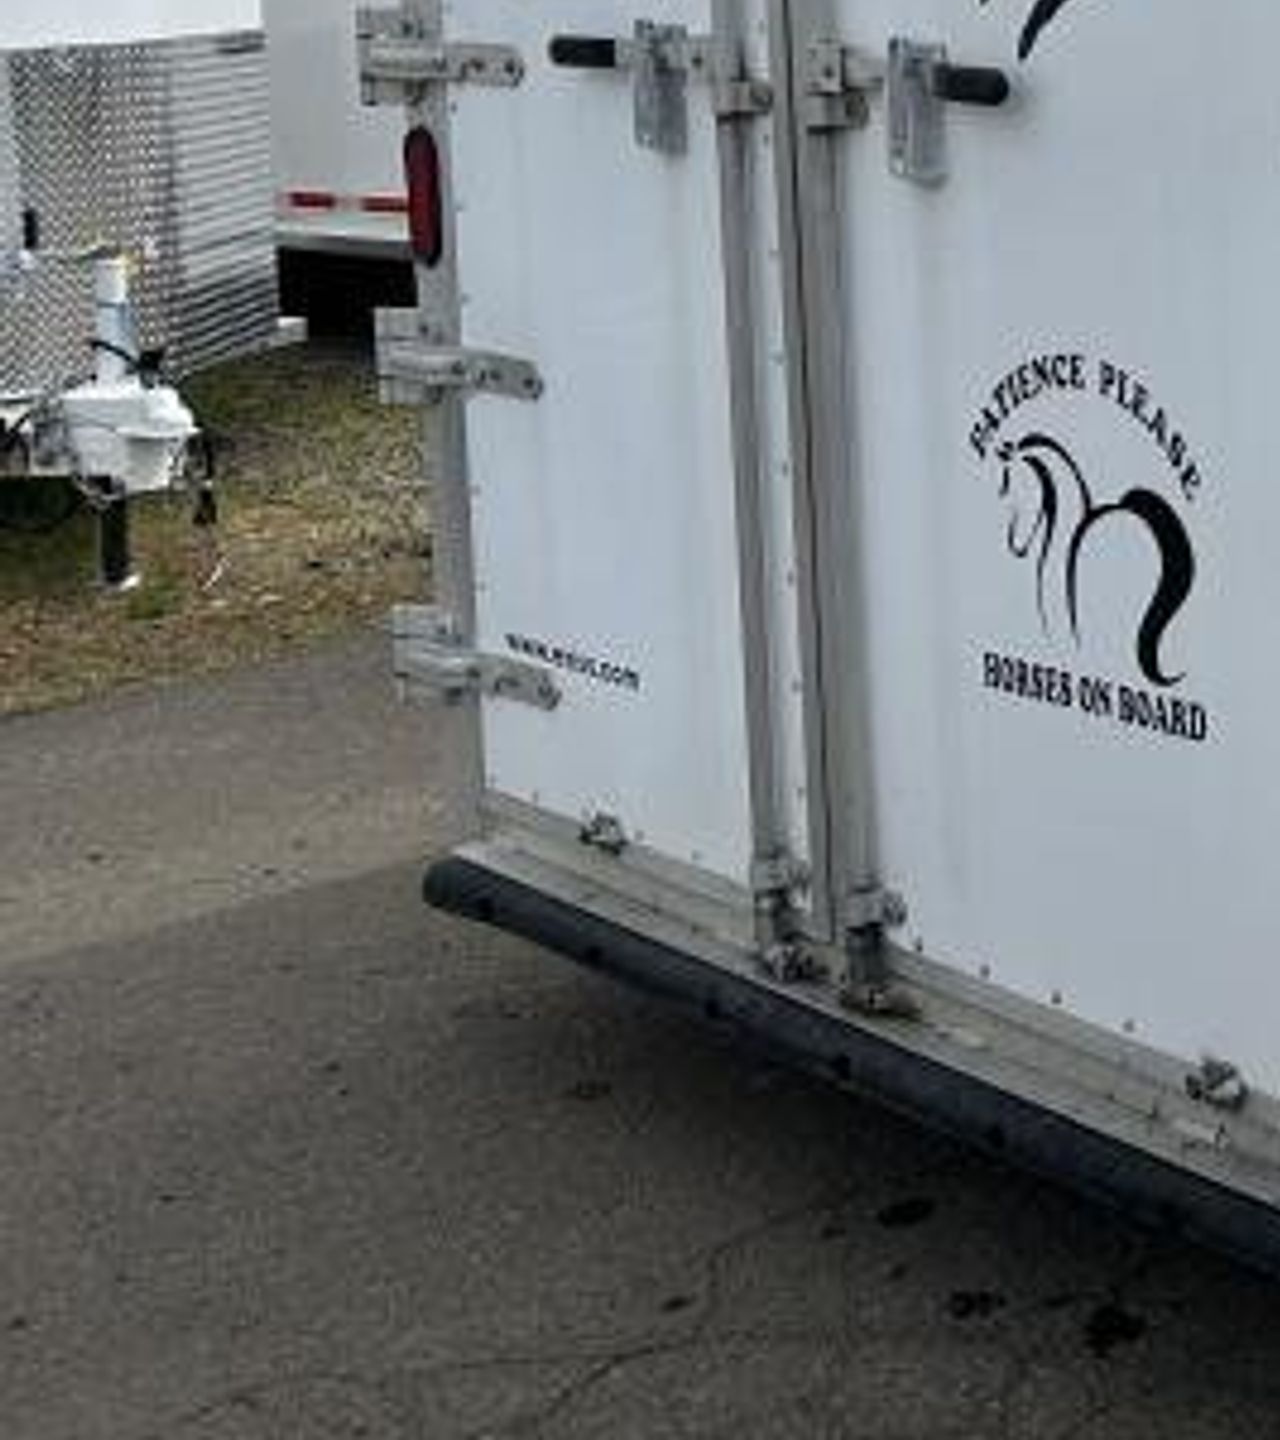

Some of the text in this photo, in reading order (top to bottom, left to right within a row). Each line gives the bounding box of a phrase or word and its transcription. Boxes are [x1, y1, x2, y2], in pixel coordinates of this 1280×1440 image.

[969, 354, 1201, 501] PATIENCE PLEASE
[983, 651, 1207, 742] HORSES ON BOARD
